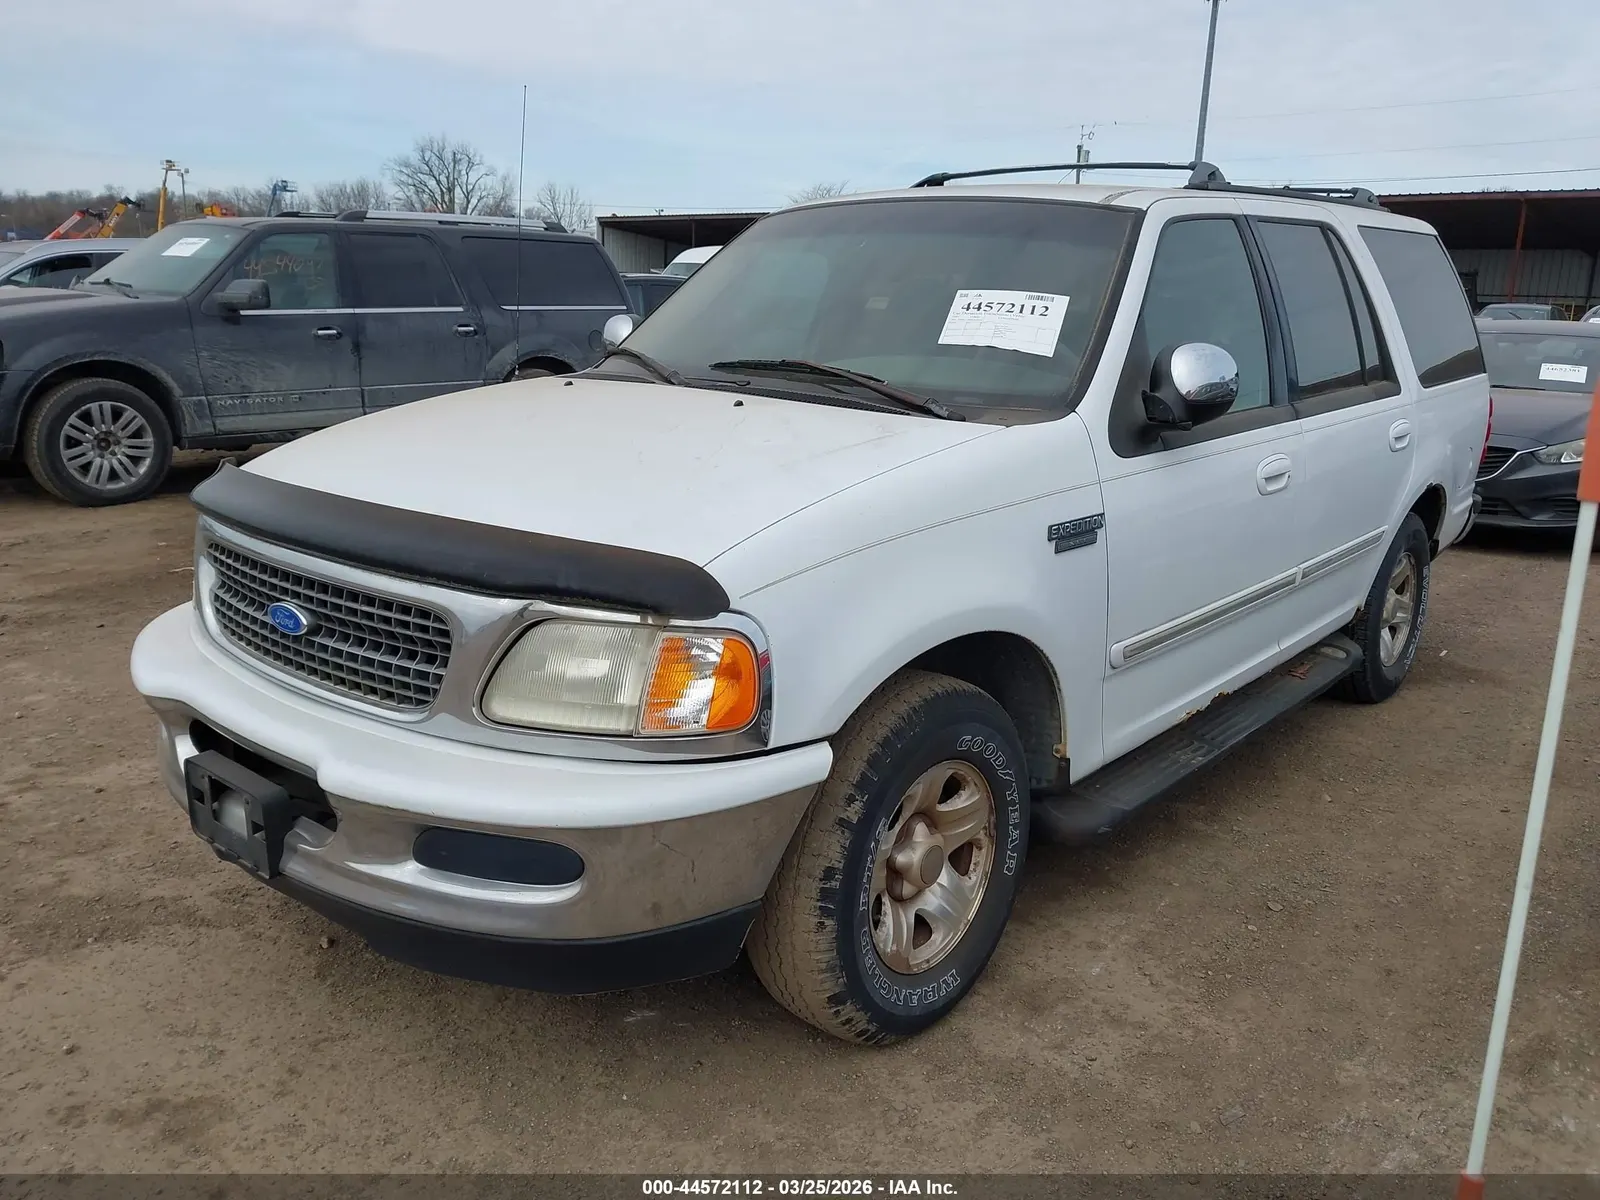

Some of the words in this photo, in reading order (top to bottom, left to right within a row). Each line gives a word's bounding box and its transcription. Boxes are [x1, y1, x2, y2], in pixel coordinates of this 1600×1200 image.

[960, 301, 1049, 317] 44572112
[217, 396, 284, 406] NAVIGATOR
[1051, 516, 1104, 538] EXPEDITION
[275, 608, 297, 628] Ford
[957, 735, 1020, 877] GOODYEAR
[860, 928, 960, 1006] WRANGLER
